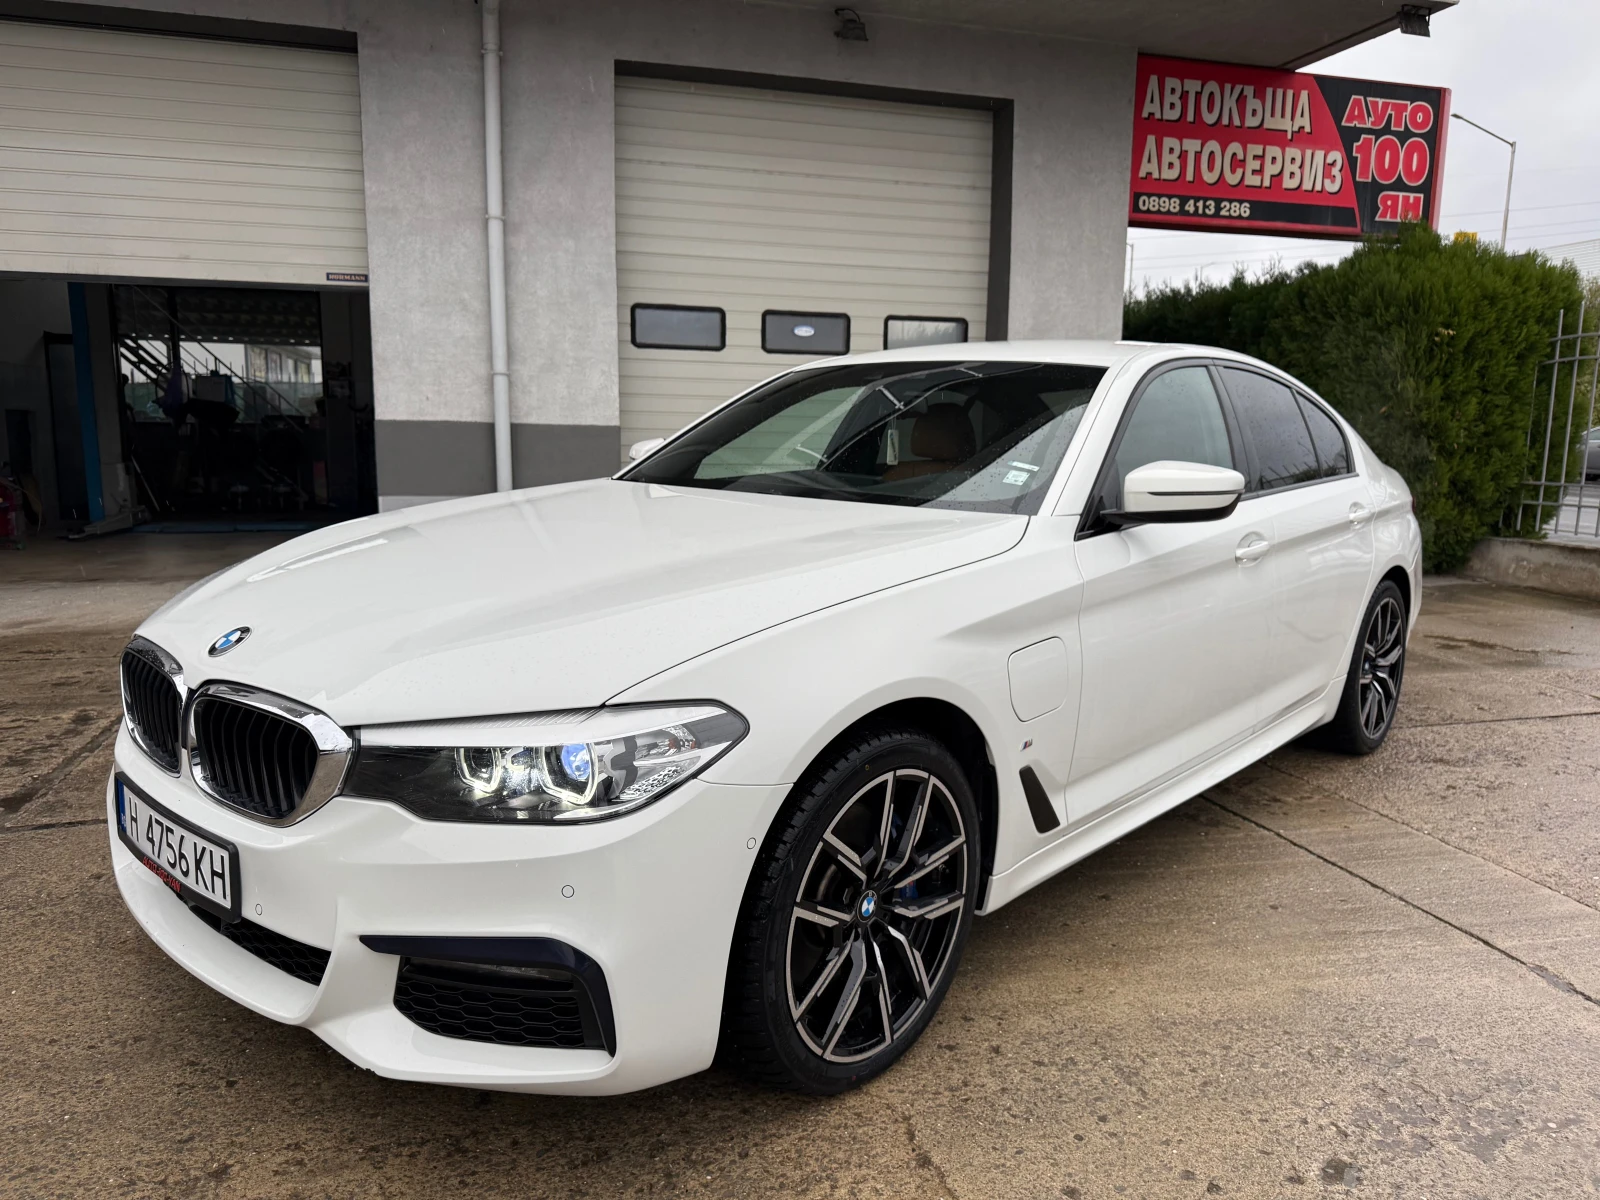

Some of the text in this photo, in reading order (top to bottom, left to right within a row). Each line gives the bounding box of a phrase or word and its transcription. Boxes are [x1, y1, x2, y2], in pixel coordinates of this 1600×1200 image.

[1142, 74, 1311, 139] АВТОКЪЩА
[1341, 95, 1433, 132] АУТО
[1138, 135, 1343, 193] АВТОСЕРВИЗ
[1353, 134, 1429, 186] 100
[1138, 196, 1251, 218] 0898 413 286
[1375, 191, 1424, 222] ЯН
[129, 797, 227, 900] H 4756 KH
